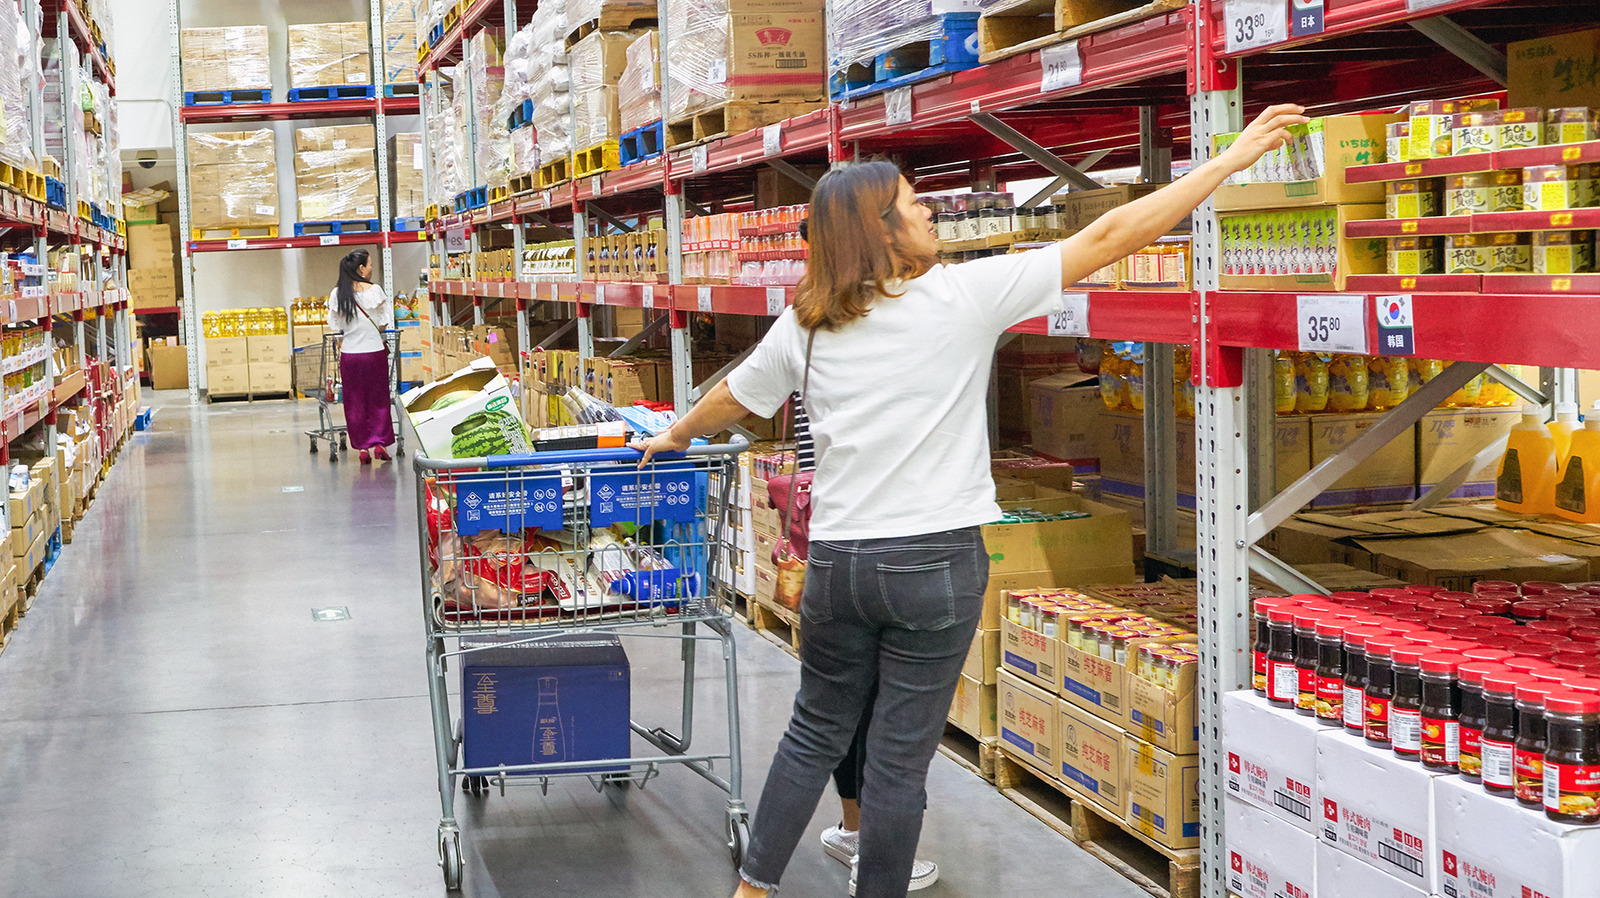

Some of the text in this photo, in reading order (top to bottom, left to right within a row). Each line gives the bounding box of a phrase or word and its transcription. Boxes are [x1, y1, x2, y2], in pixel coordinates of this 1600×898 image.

[1301, 15, 1315, 28] 日本
[1340, 138, 1380, 148] いちばん
[1388, 335, 1404, 348] 韩国
[1244, 760, 1268, 782] 韩式腌肉
[1342, 807, 1371, 832] 韩式腌肉
[1463, 861, 1496, 889] 韩式腌肉
